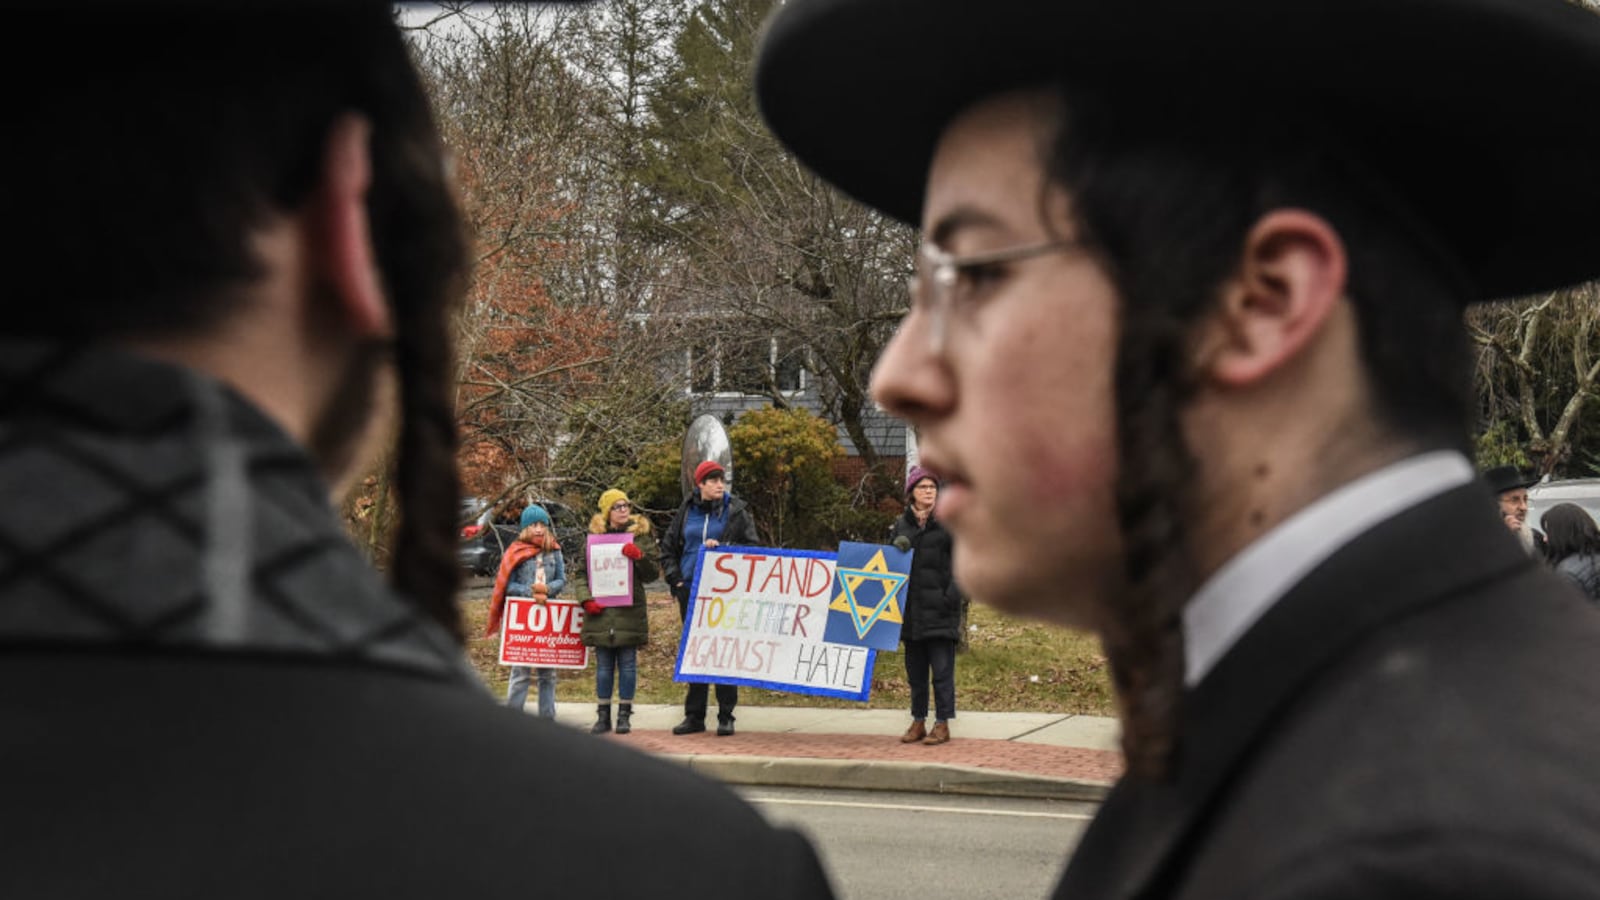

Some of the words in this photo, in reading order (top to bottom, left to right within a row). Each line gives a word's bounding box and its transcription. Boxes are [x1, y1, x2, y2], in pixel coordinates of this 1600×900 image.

[711, 554, 831, 598] STAND
[508, 602, 585, 633] LOVE
[698, 596, 811, 638] TOGETHER
[506, 634, 533, 645] your
[685, 635, 782, 674] AGAINST
[794, 643, 865, 689] HATE
